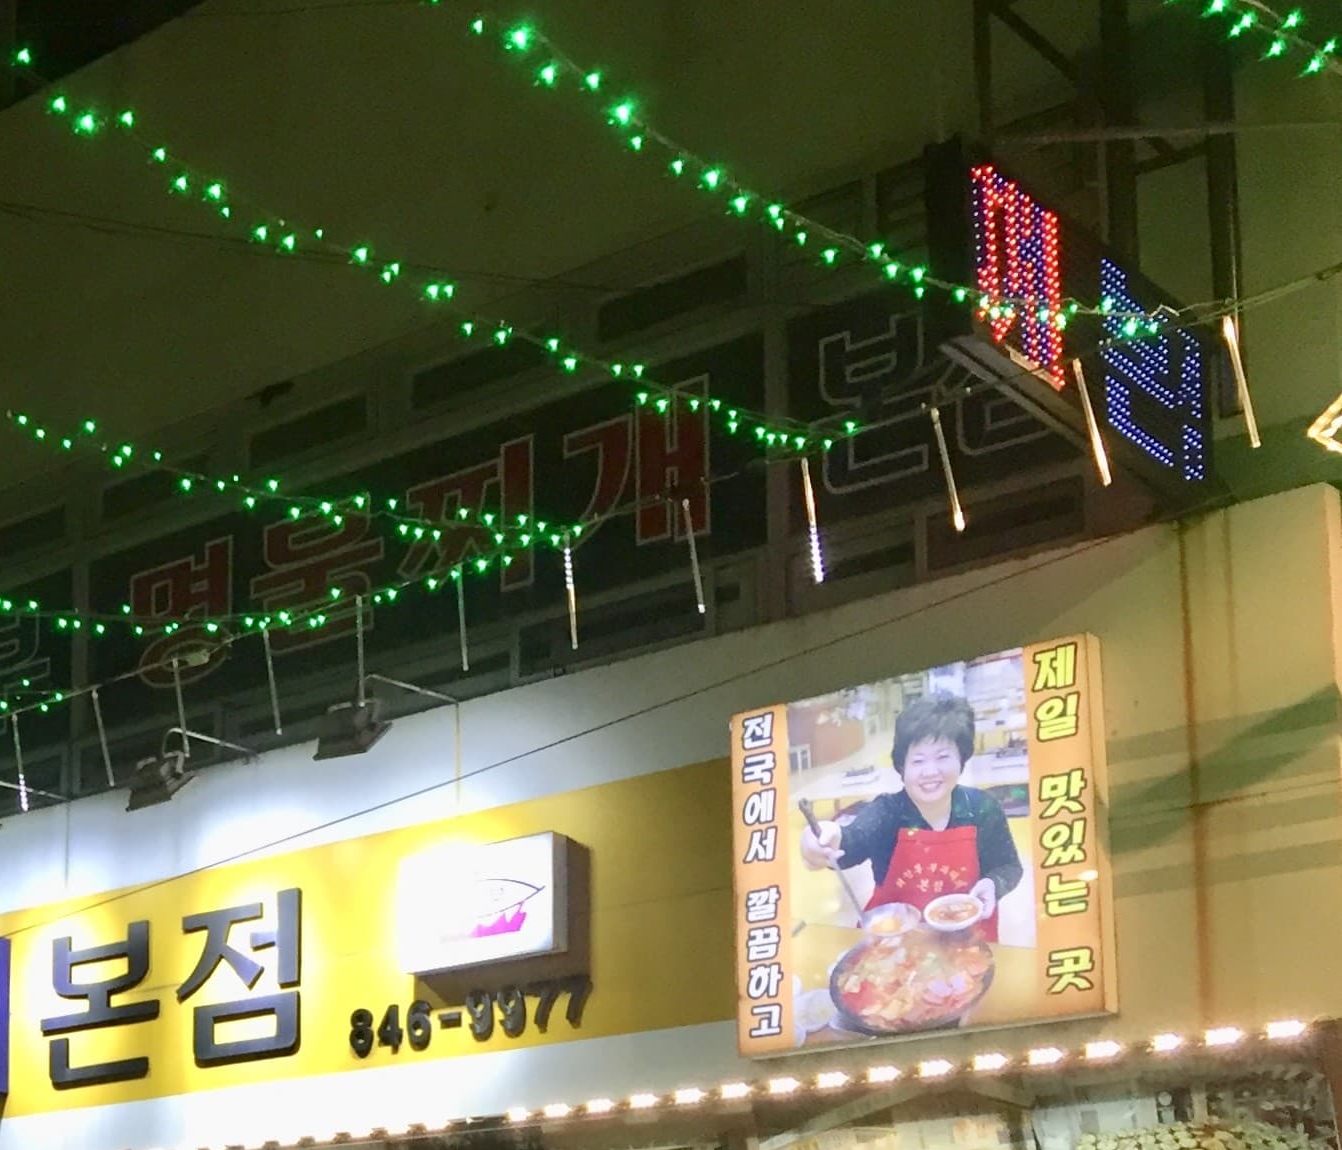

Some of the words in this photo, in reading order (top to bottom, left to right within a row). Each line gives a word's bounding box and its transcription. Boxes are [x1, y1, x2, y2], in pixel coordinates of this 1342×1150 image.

[126, 373, 712, 690] 명물찌개
[1032, 643, 1080, 742] 제일
[742, 712, 779, 863] 전국에서
[1040, 768, 1090, 917] 맛있는
[40, 888, 303, 1090] 본점
[349, 974, 594, 1059] 846-9977
[746, 887, 784, 1038] 깔끔하고
[1048, 947, 1095, 994] 곳
